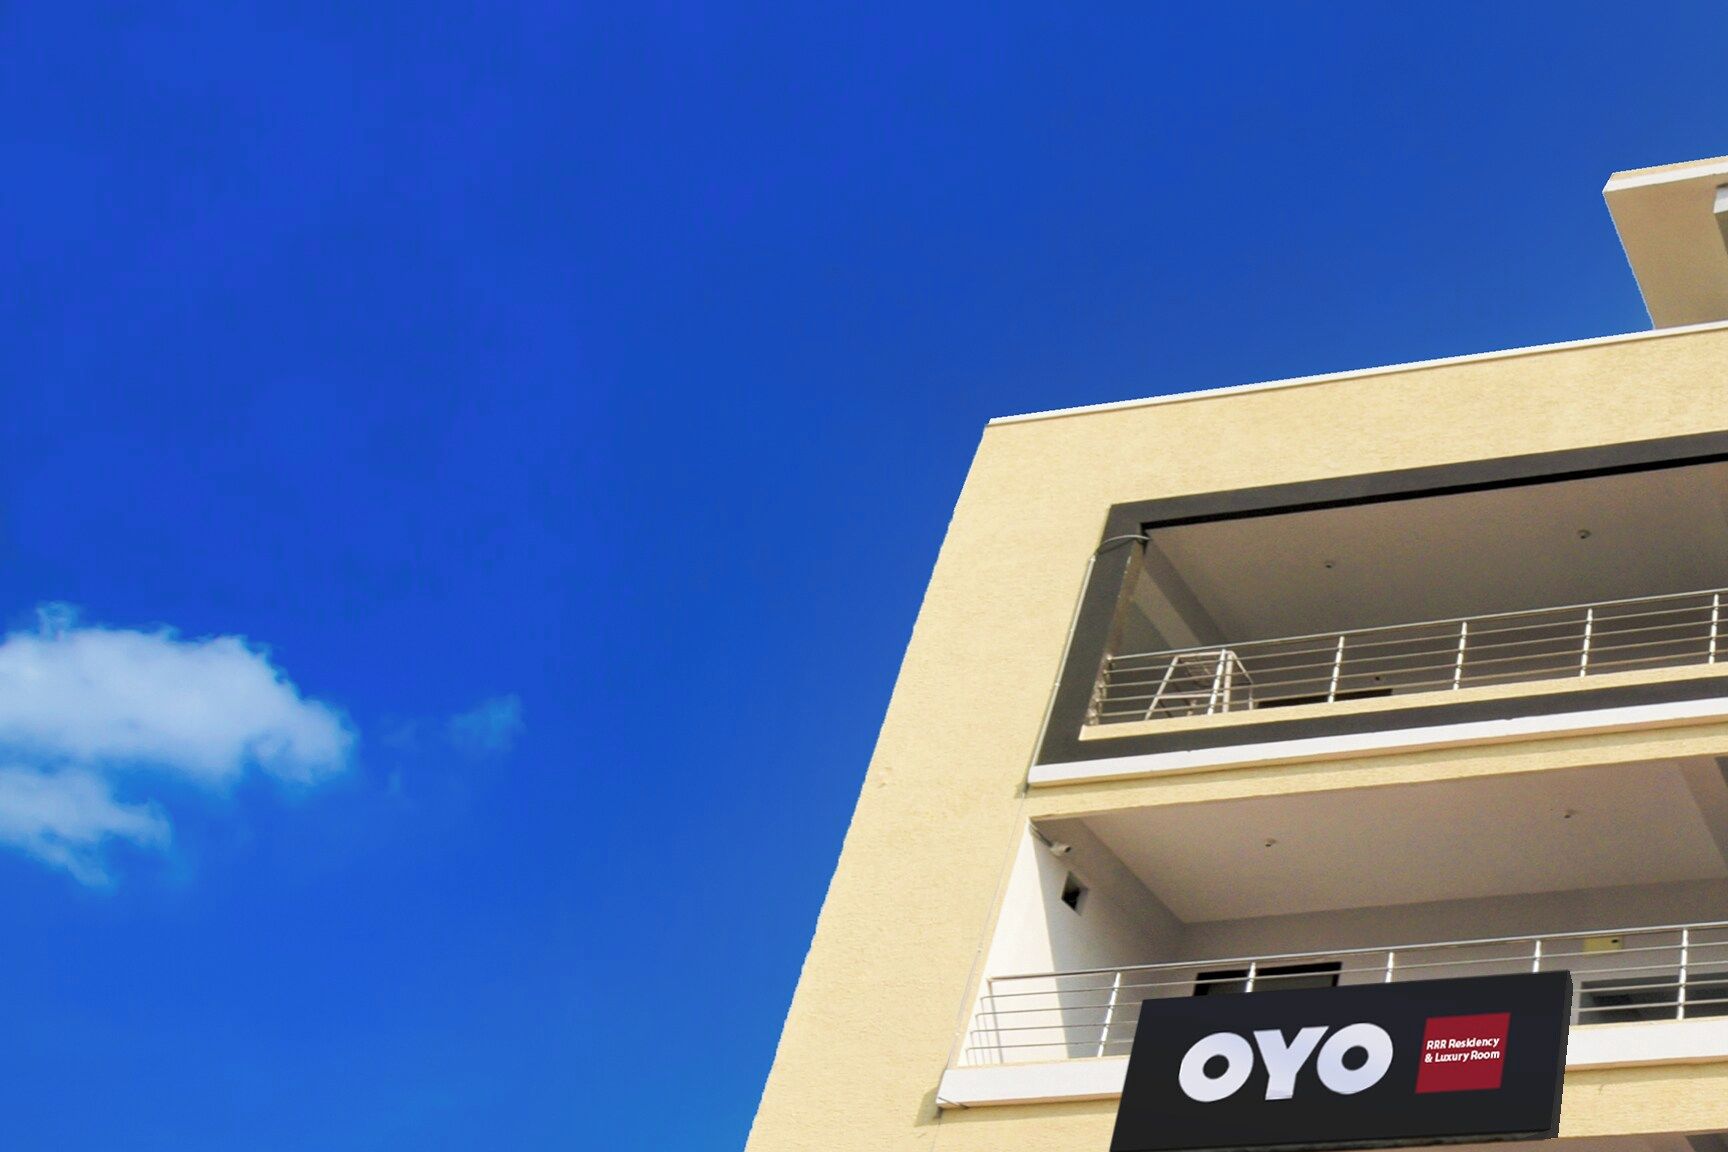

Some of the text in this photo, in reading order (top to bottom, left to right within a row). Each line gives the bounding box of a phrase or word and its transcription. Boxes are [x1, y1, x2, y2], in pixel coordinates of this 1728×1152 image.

[1426, 1037, 1500, 1050] RRR Residency
[1179, 1023, 1393, 1102] OYO
[1424, 1050, 1500, 1063] & Luxury Room
